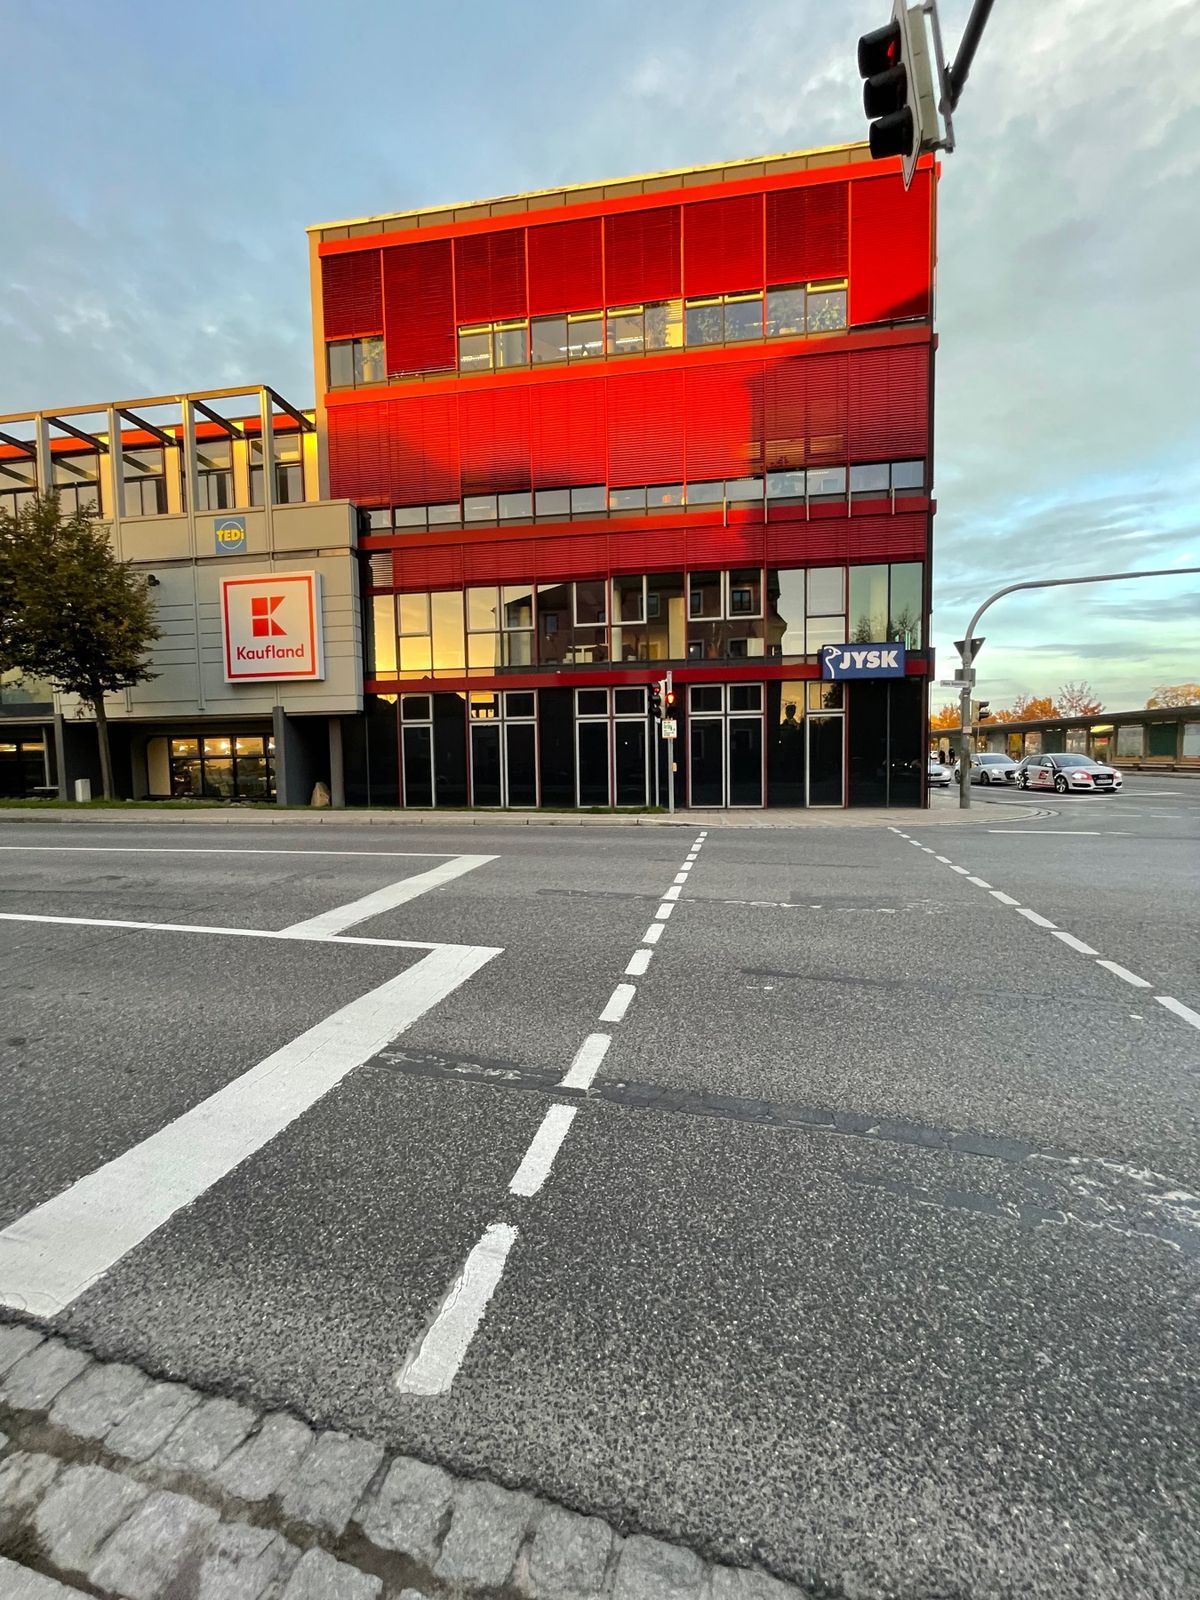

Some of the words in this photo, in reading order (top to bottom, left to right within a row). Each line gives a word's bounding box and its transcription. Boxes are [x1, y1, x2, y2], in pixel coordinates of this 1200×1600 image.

[216, 528, 245, 542] TEDi
[236, 643, 305, 660] Kaufland
[839, 650, 899, 670] JYSK
